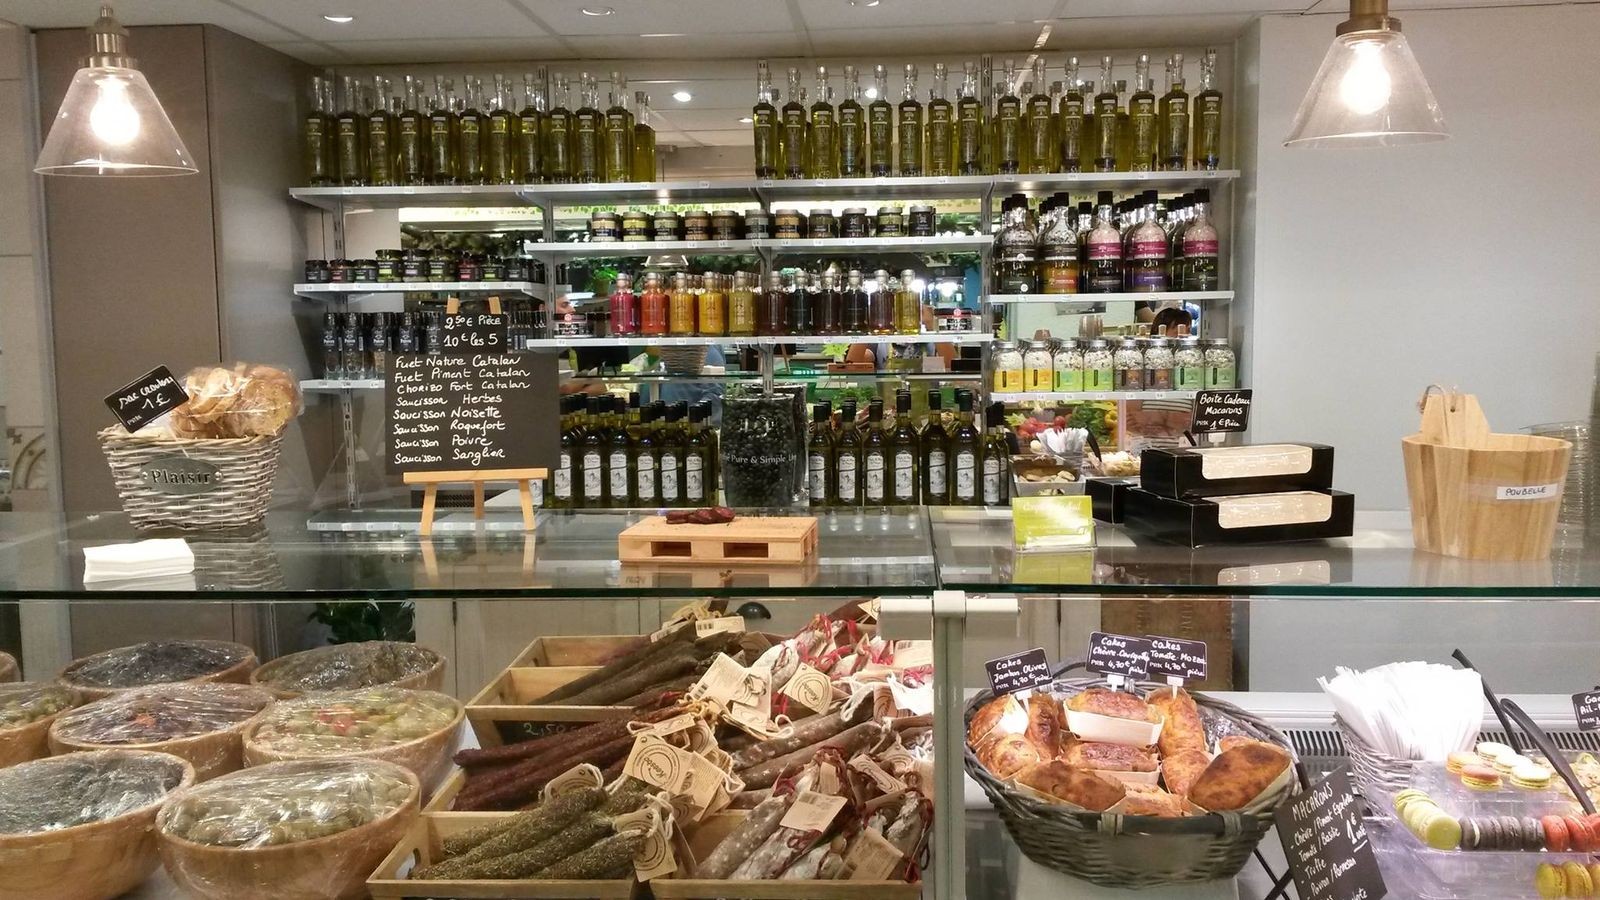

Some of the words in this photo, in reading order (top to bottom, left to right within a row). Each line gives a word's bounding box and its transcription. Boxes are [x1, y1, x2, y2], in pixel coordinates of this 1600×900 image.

[478, 314, 502, 326] Pièce
[470, 332, 485, 347] les
[488, 333, 499, 345] 5
[395, 356, 424, 369] Fuet
[426, 356, 467, 367] Nature
[472, 354, 521, 368] Catalan
[394, 372, 424, 383] Fuet
[431, 368, 472, 380] Piment
[478, 369, 531, 378] Catalan
[449, 382, 473, 392] Fort
[481, 379, 531, 390] Catalan
[395, 397, 449, 407] Saucisson
[462, 394, 503, 405] Herbes
[393, 409, 446, 420] Saucisson
[450, 406, 502, 419] Noisette
[1205, 406, 1243, 416] Macarons
[393, 423, 440, 435] Saucisson
[450, 419, 506, 436] Roquefort
[394, 438, 440, 449] Saucisson
[451, 435, 494, 447] Poivre
[394, 453, 442, 465] Saucisson
[452, 449, 506, 466] Sanglier
[731, 454, 748, 464] Pure
[750, 455, 758, 464] &
[151, 469, 210, 485] Plaisir
[1505, 486, 1547, 497] POUBELLE
[1101, 637, 1127, 648] Cakes
[1151, 640, 1181, 651] Cakes
[996, 659, 1022, 670] Cakes
[1291, 781, 1333, 822] MACARONS
